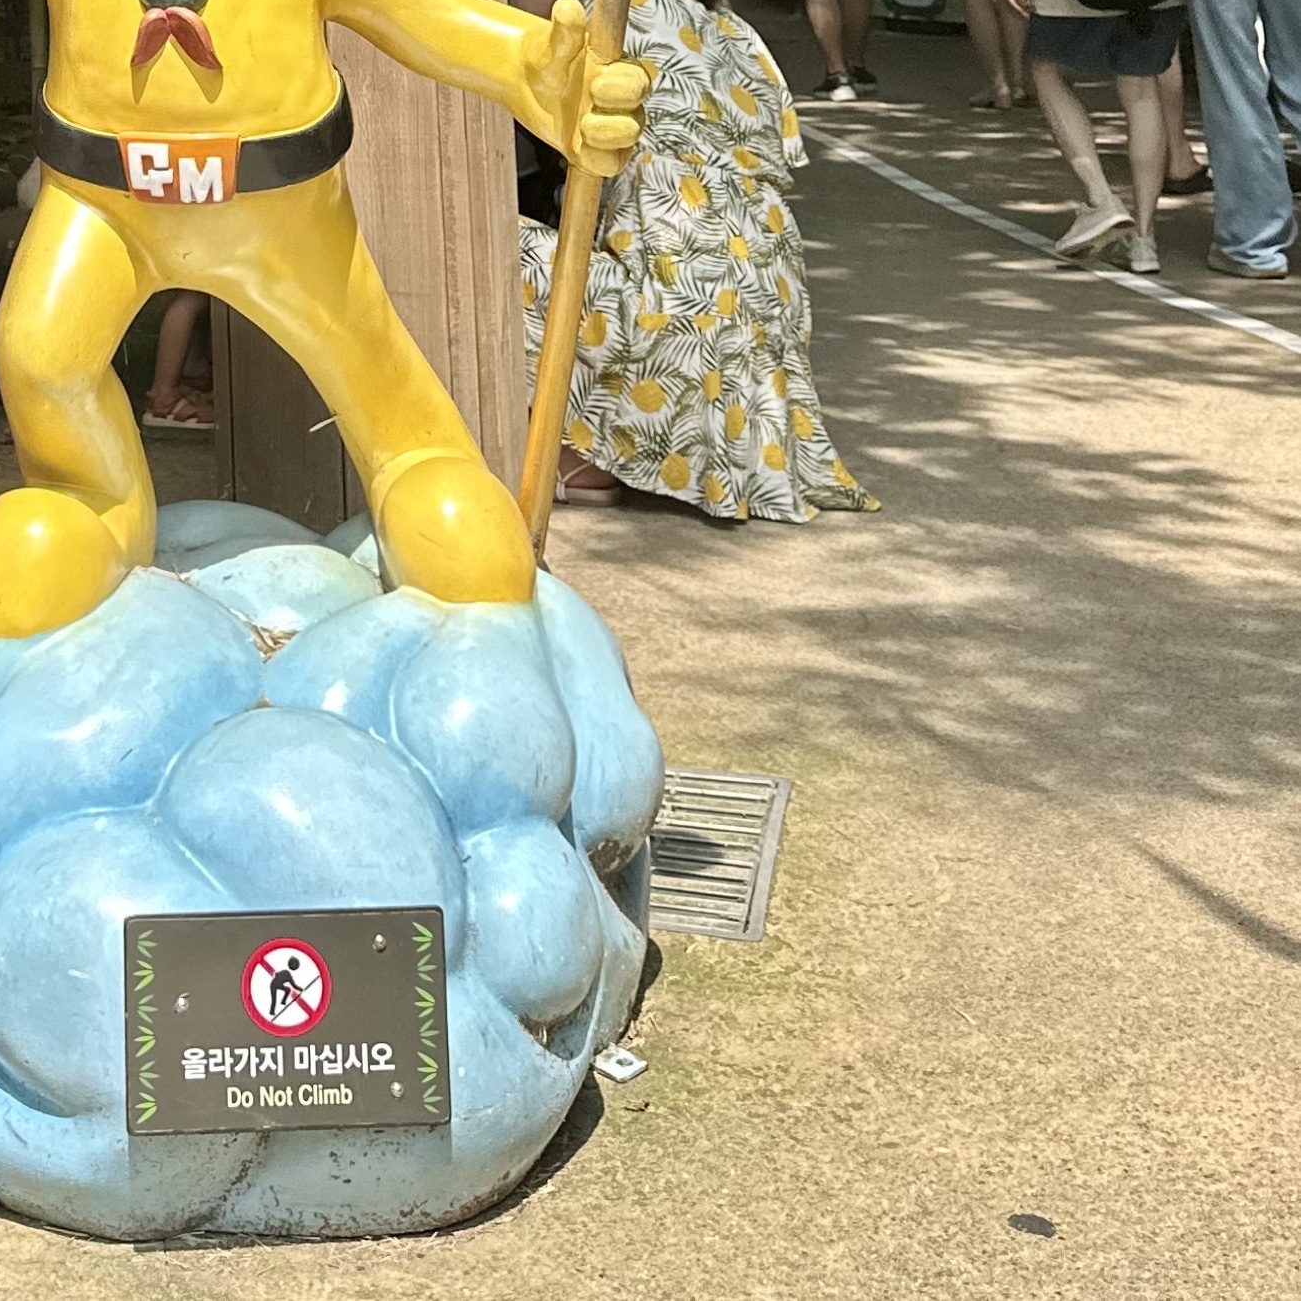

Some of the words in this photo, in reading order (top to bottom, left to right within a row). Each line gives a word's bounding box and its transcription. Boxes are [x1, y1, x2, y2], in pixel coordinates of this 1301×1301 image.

[127, 142, 224, 204] GM
[181, 1047, 284, 1080] 올라가지
[294, 1042, 396, 1076] 마십시오
[227, 1087, 254, 1108] Do
[259, 1086, 293, 1107] Not
[299, 1084, 353, 1106] Climb
